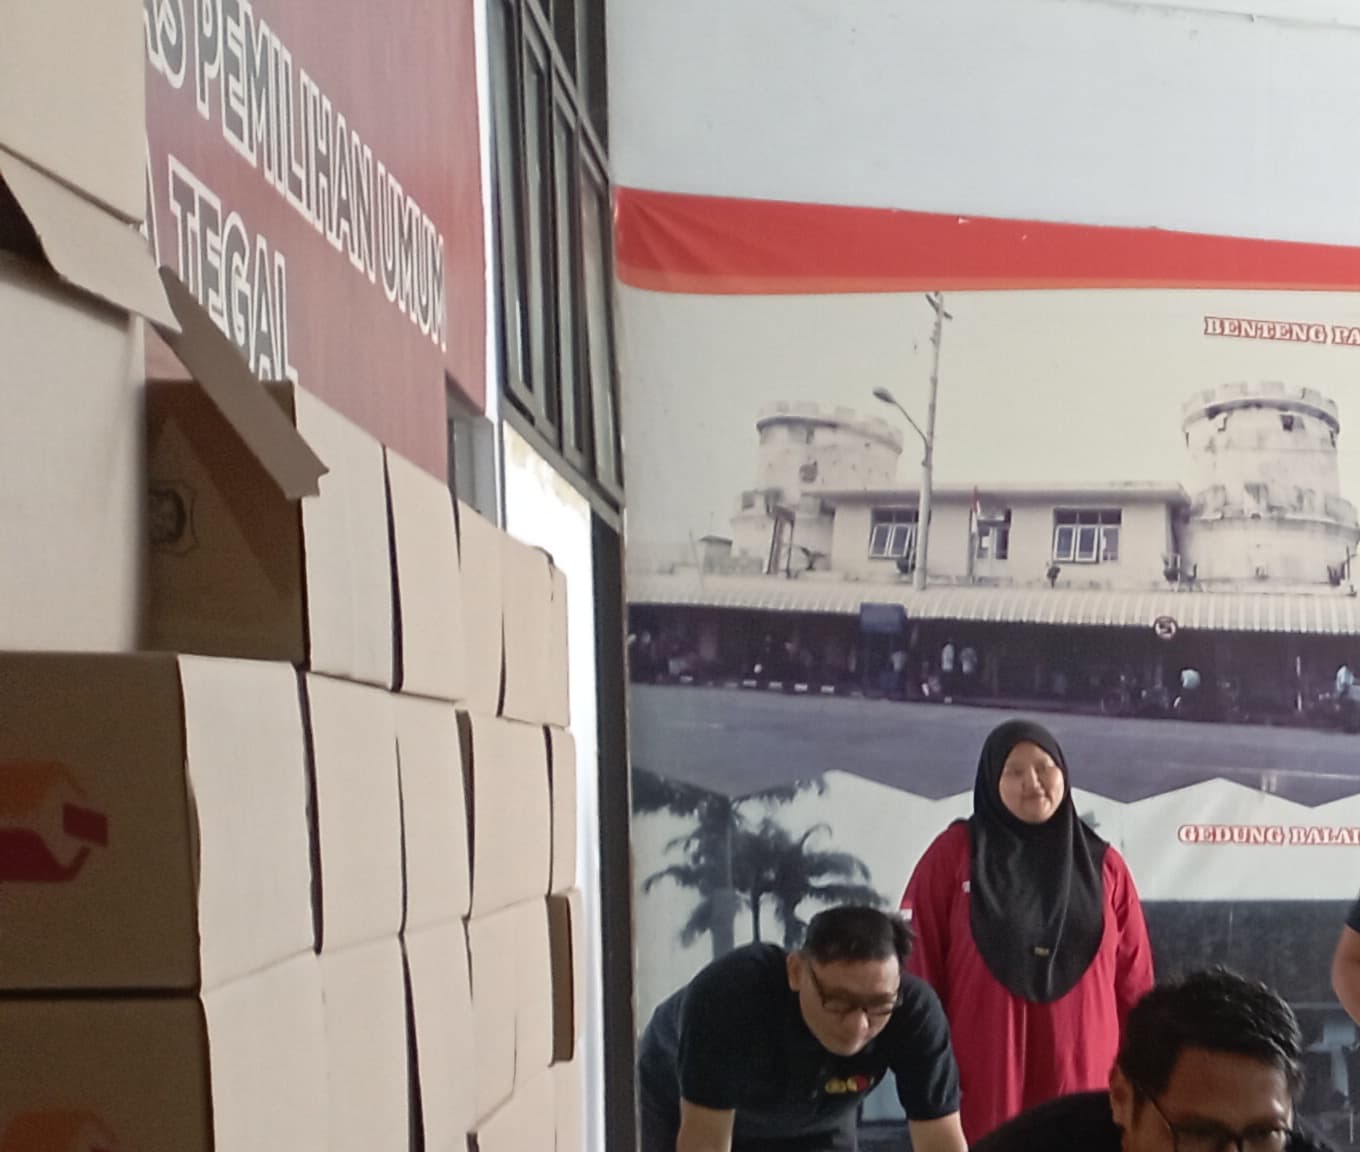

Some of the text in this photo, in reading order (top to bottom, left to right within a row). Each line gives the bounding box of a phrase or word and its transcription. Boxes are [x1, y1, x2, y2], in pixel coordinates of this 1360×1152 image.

[193, 0, 447, 353] PEMILIHAN UMUM
[167, 154, 299, 381] TEGAL
[1204, 316, 1328, 344] BENTENG
[1177, 823, 1286, 846] GEDUNG
[1289, 825, 1360, 847] BALAI
